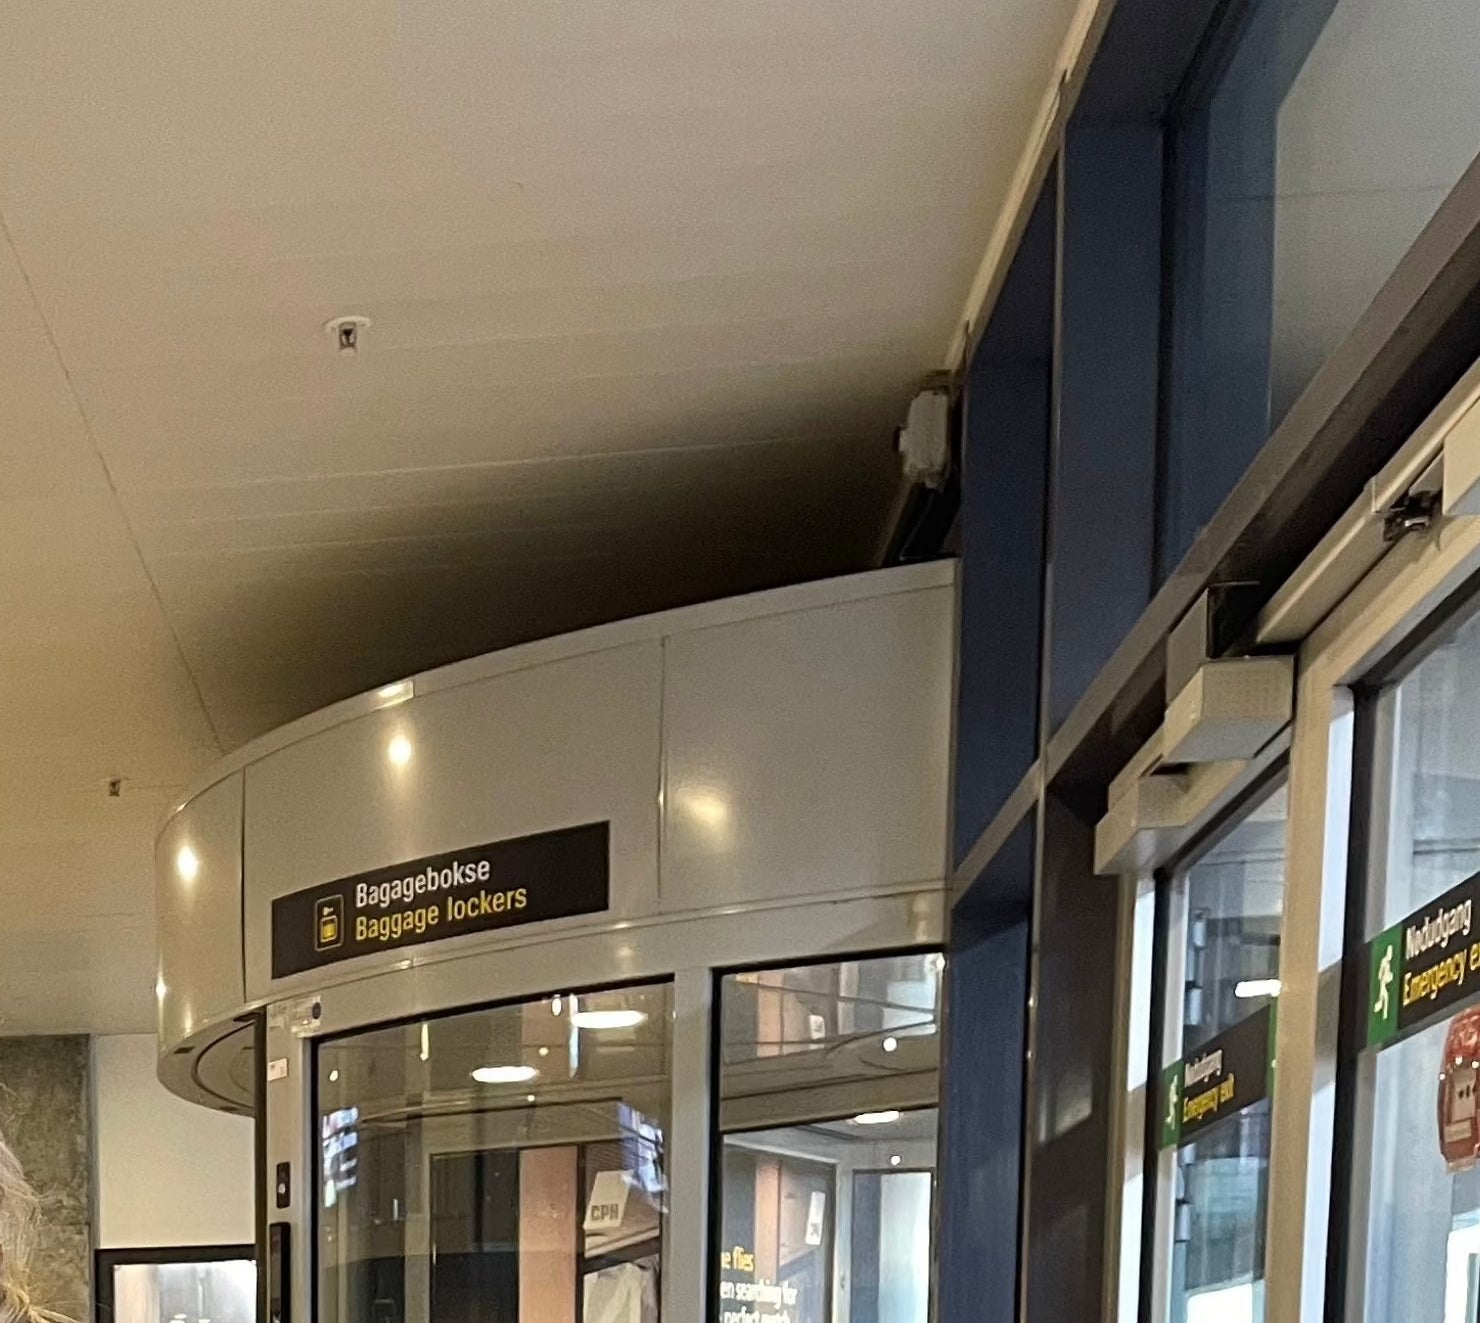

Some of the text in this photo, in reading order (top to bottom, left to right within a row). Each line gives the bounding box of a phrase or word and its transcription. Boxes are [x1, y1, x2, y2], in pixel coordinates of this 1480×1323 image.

[355, 859, 491, 908] Bagagebokse
[355, 887, 528, 941] Baggage lockers
